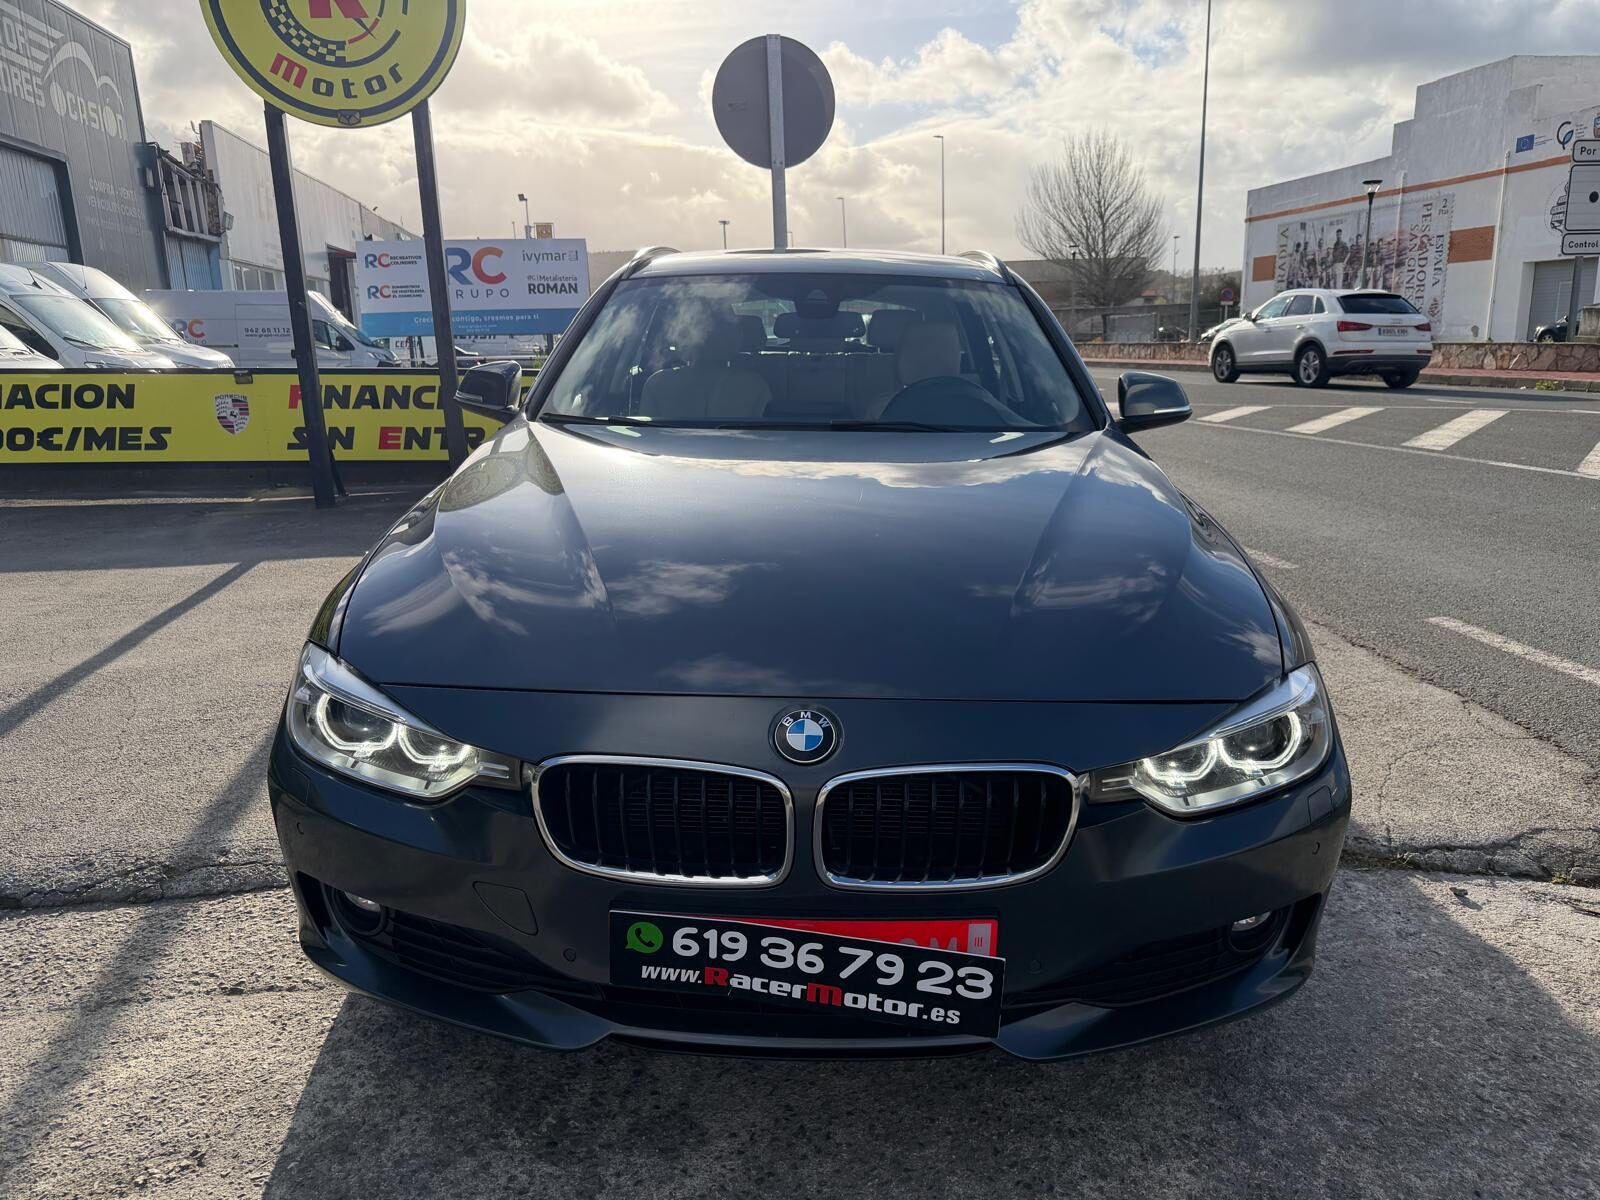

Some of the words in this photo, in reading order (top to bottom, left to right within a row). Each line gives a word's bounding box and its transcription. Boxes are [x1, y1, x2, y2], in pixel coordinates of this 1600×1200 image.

[1580, 146, 1597, 156] Por
[1568, 240, 1599, 249] Control
[365, 253, 391, 268] RC
[522, 249, 567, 264] ivymar
[445, 247, 507, 285] RC
[367, 285, 391, 299] RC
[455, 288, 510, 299] RUPO
[527, 283, 578, 294] ROMAN
[0, 384, 135, 409] ACION
[0, 427, 172, 451] 0€/MES
[287, 427, 355, 450] SN
[781, 711, 830, 728] BMW
[672, 926, 748, 962] 619
[760, 936, 824, 974] 36
[838, 946, 905, 986] 79
[916, 960, 994, 1000] 23
